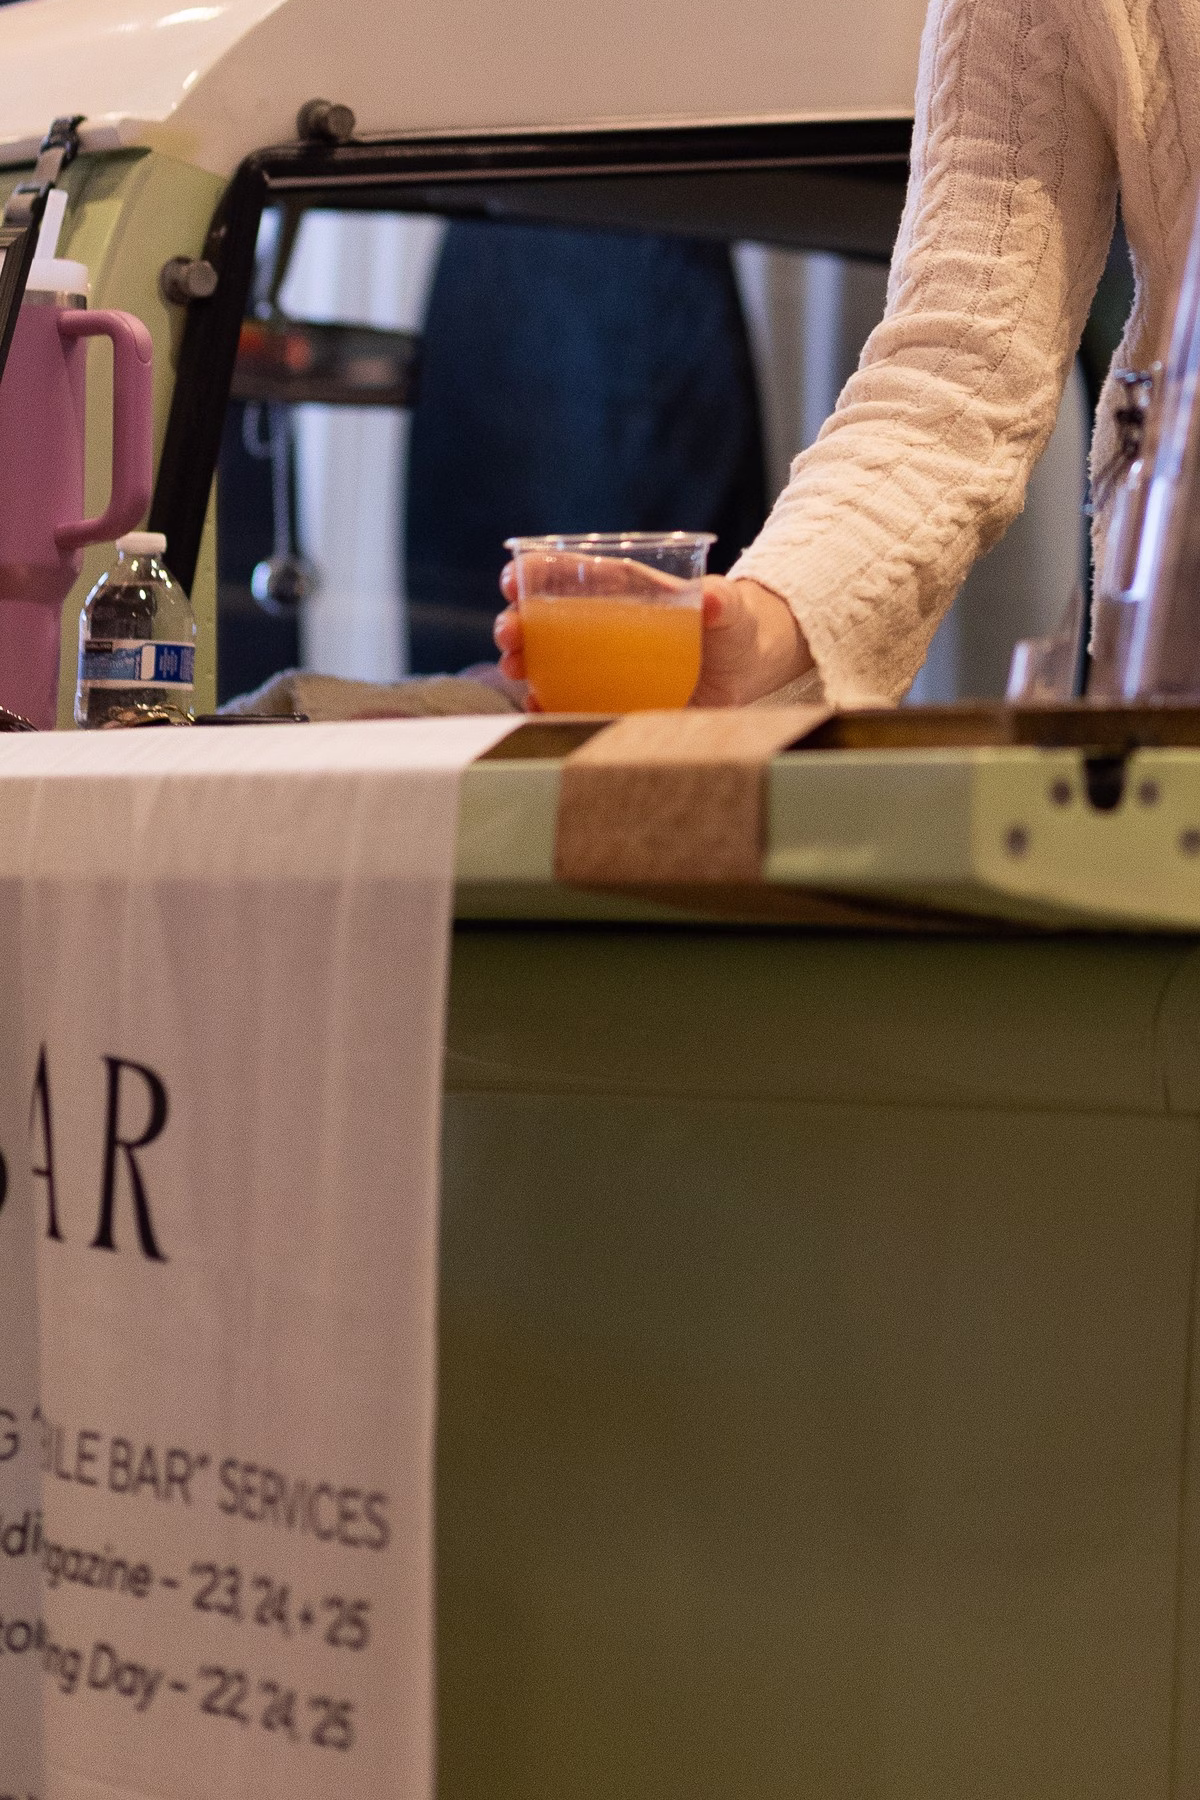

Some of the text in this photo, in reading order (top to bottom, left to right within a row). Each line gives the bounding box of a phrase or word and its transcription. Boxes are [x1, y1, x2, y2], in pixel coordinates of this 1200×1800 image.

[0, 1040, 169, 1264] AR
[217, 1455, 393, 1552] SERVICES
[87, 1640, 164, 1712] Day
